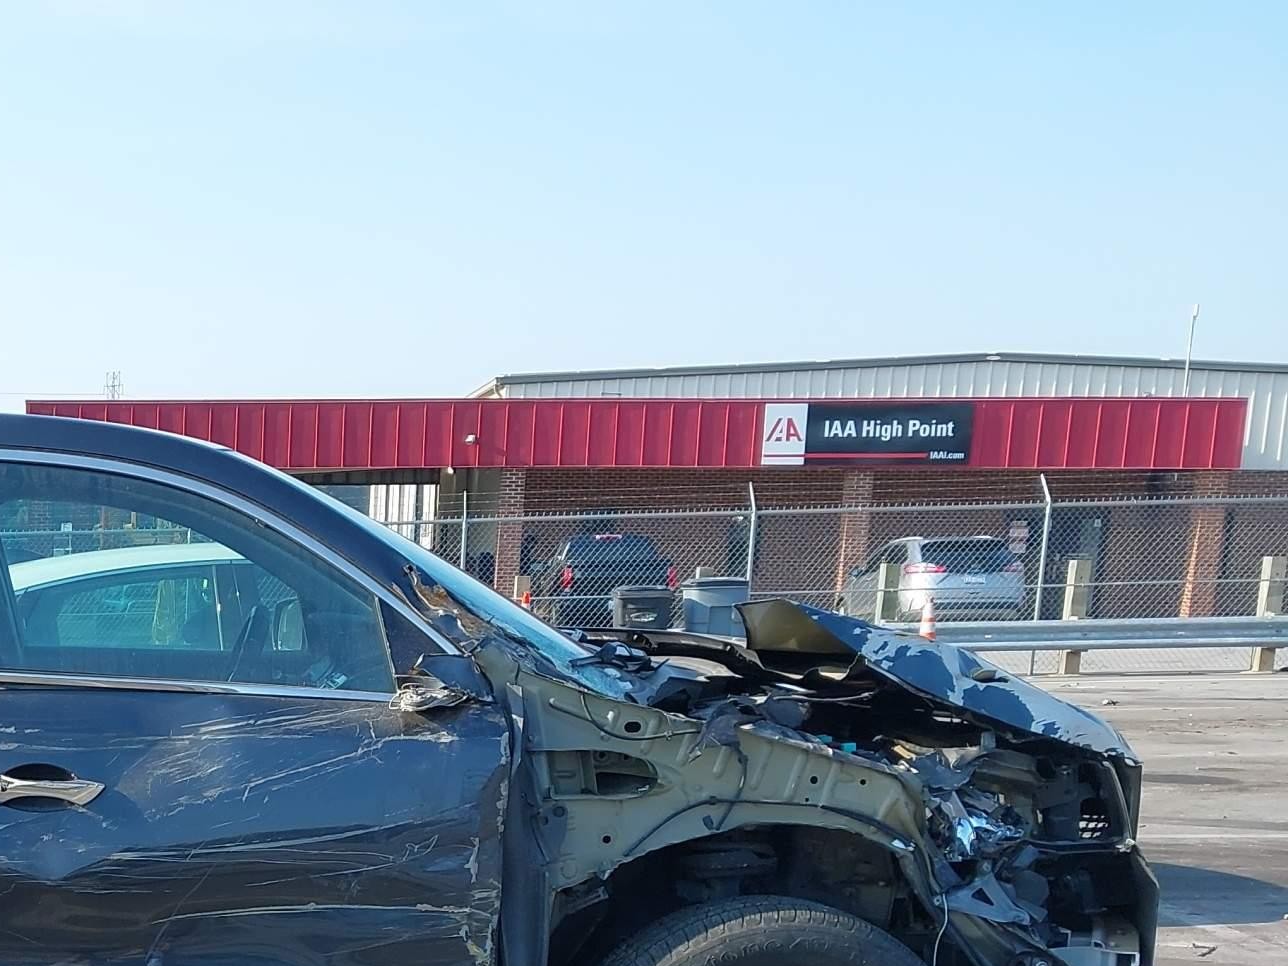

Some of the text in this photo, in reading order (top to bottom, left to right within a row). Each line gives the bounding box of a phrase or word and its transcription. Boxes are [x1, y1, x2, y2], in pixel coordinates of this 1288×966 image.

[823, 419, 955, 441] IAA High Point
